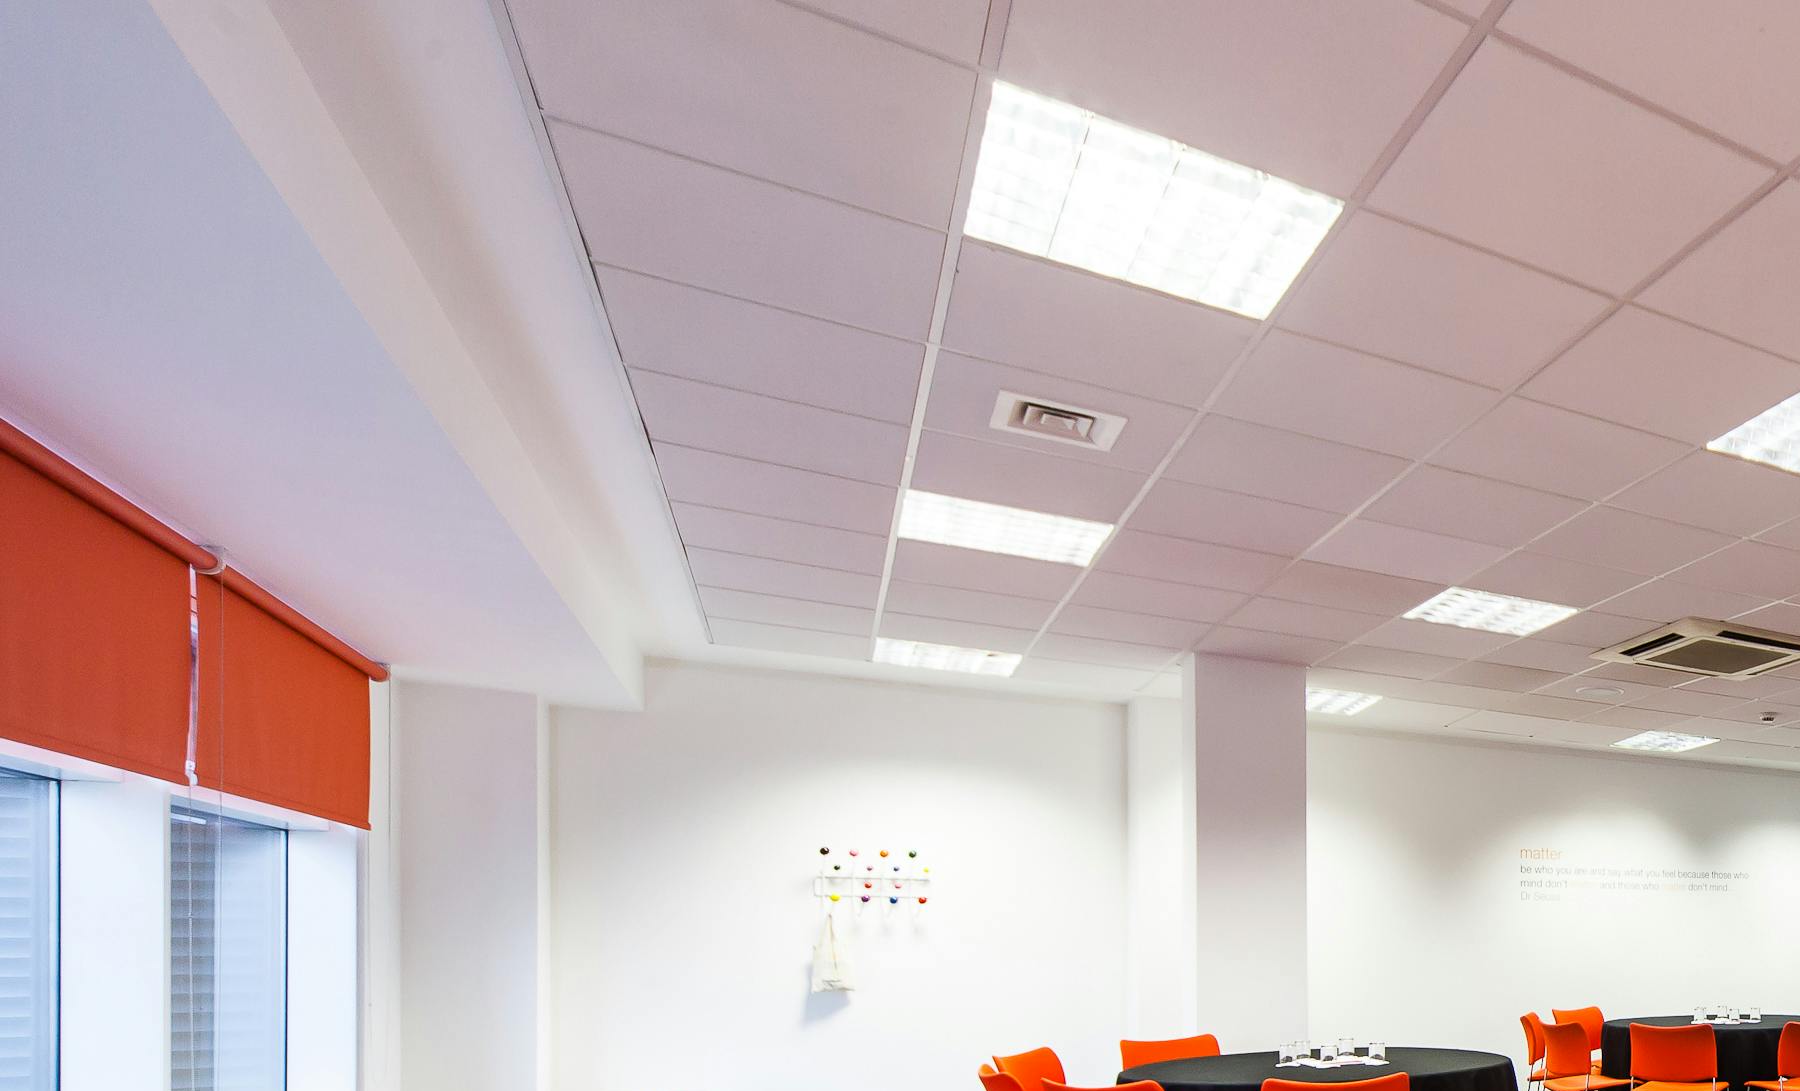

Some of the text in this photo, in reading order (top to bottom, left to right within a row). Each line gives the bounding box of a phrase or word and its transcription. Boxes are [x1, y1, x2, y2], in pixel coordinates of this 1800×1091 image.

[1520, 848, 1563, 860] matter
[1520, 864, 1533, 874] be
[1535, 864, 1554, 874] who
[1556, 867, 1572, 877] you
[1646, 870, 1660, 880] you
[1662, 869, 1676, 878] feel
[1677, 870, 1709, 879] because
[1711, 870, 1732, 880] those
[1733, 871, 1750, 880] who
[1520, 879, 1543, 889] mind
[1545, 879, 1568, 889] don't
[1688, 882, 1707, 891] don't
[1709, 882, 1728, 892] mind
[1520, 891, 1531, 901] Dr
